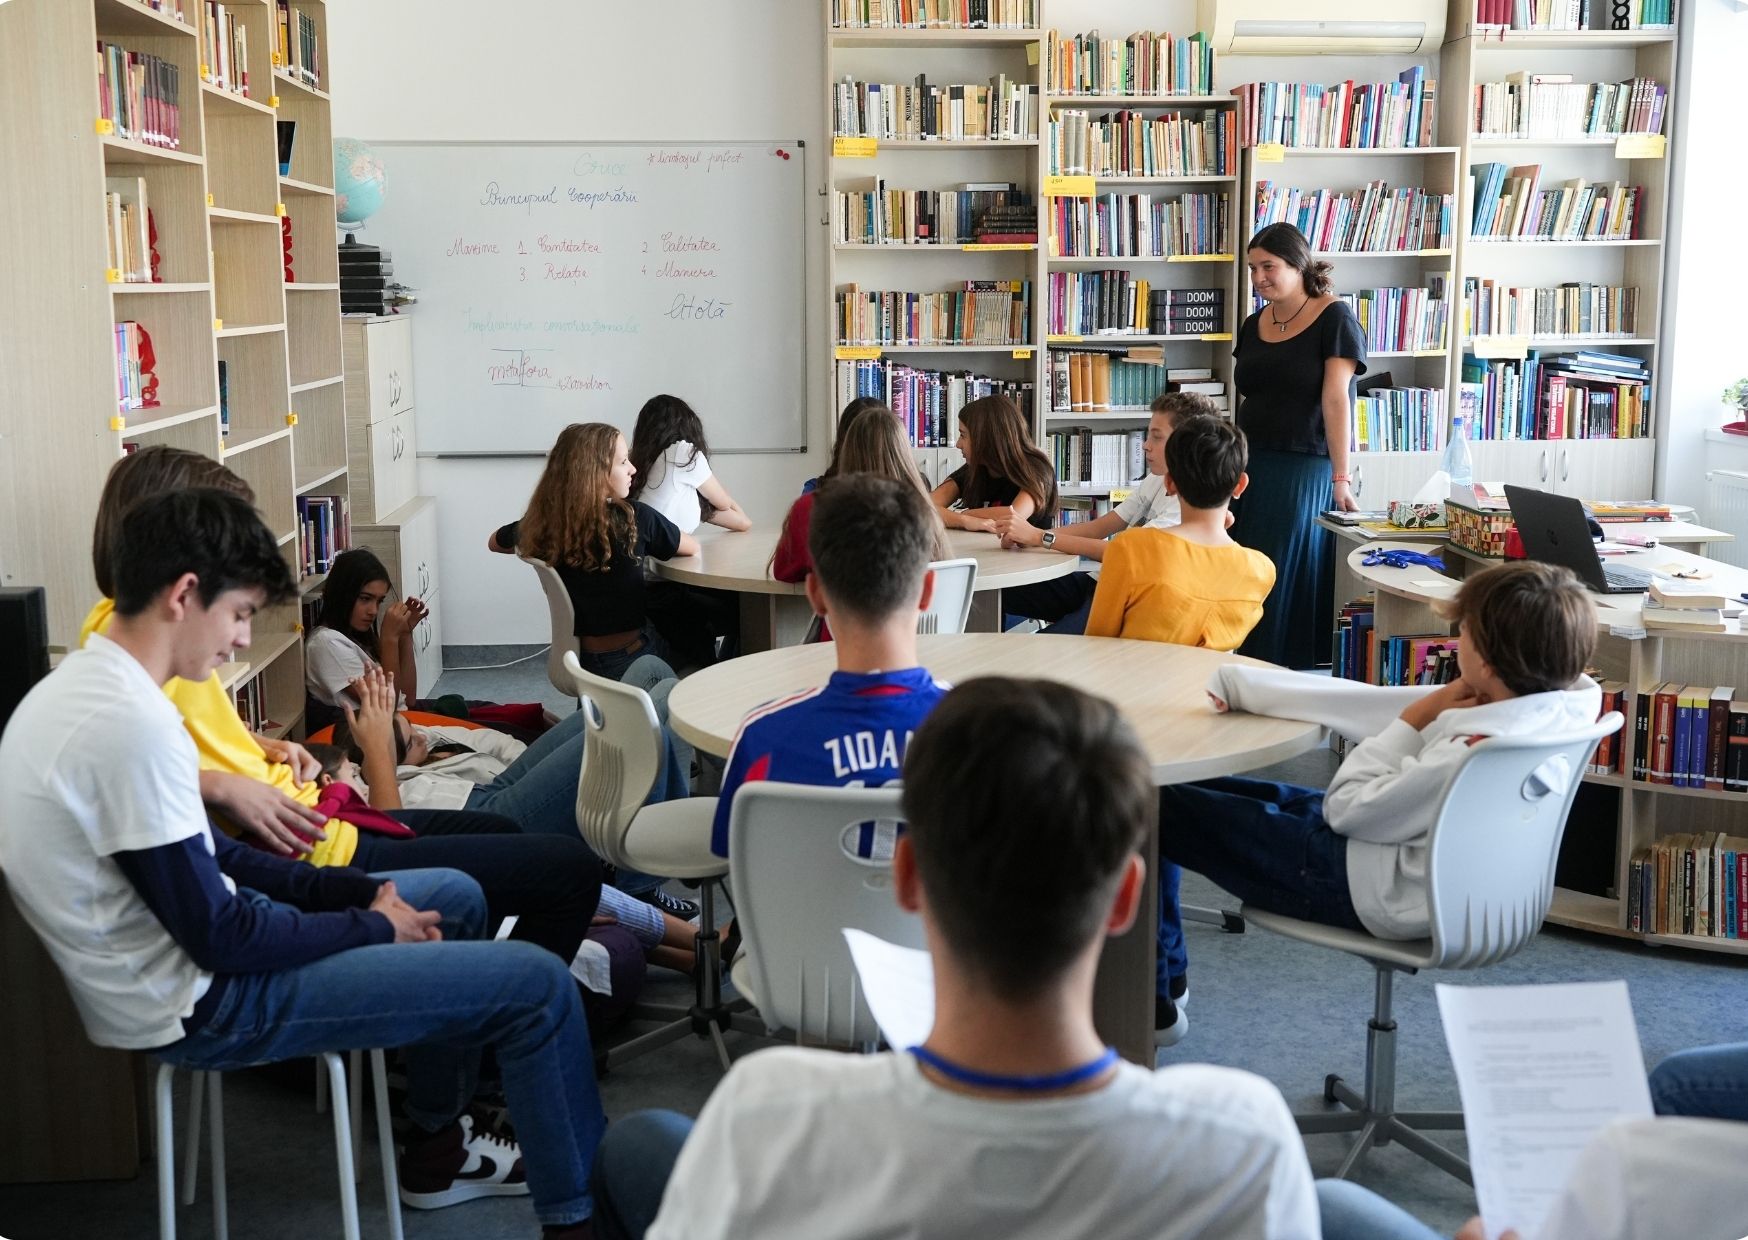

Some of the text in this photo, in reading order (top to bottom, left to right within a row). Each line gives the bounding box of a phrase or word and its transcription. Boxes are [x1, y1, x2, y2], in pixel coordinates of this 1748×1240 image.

[537, 234, 602, 254] Cantitatea
[660, 231, 721, 253] Calitatea
[1187, 292, 1214, 303] DOOM
[1185, 307, 1213, 318] DOOM
[1185, 321, 1213, 333] DOOM
